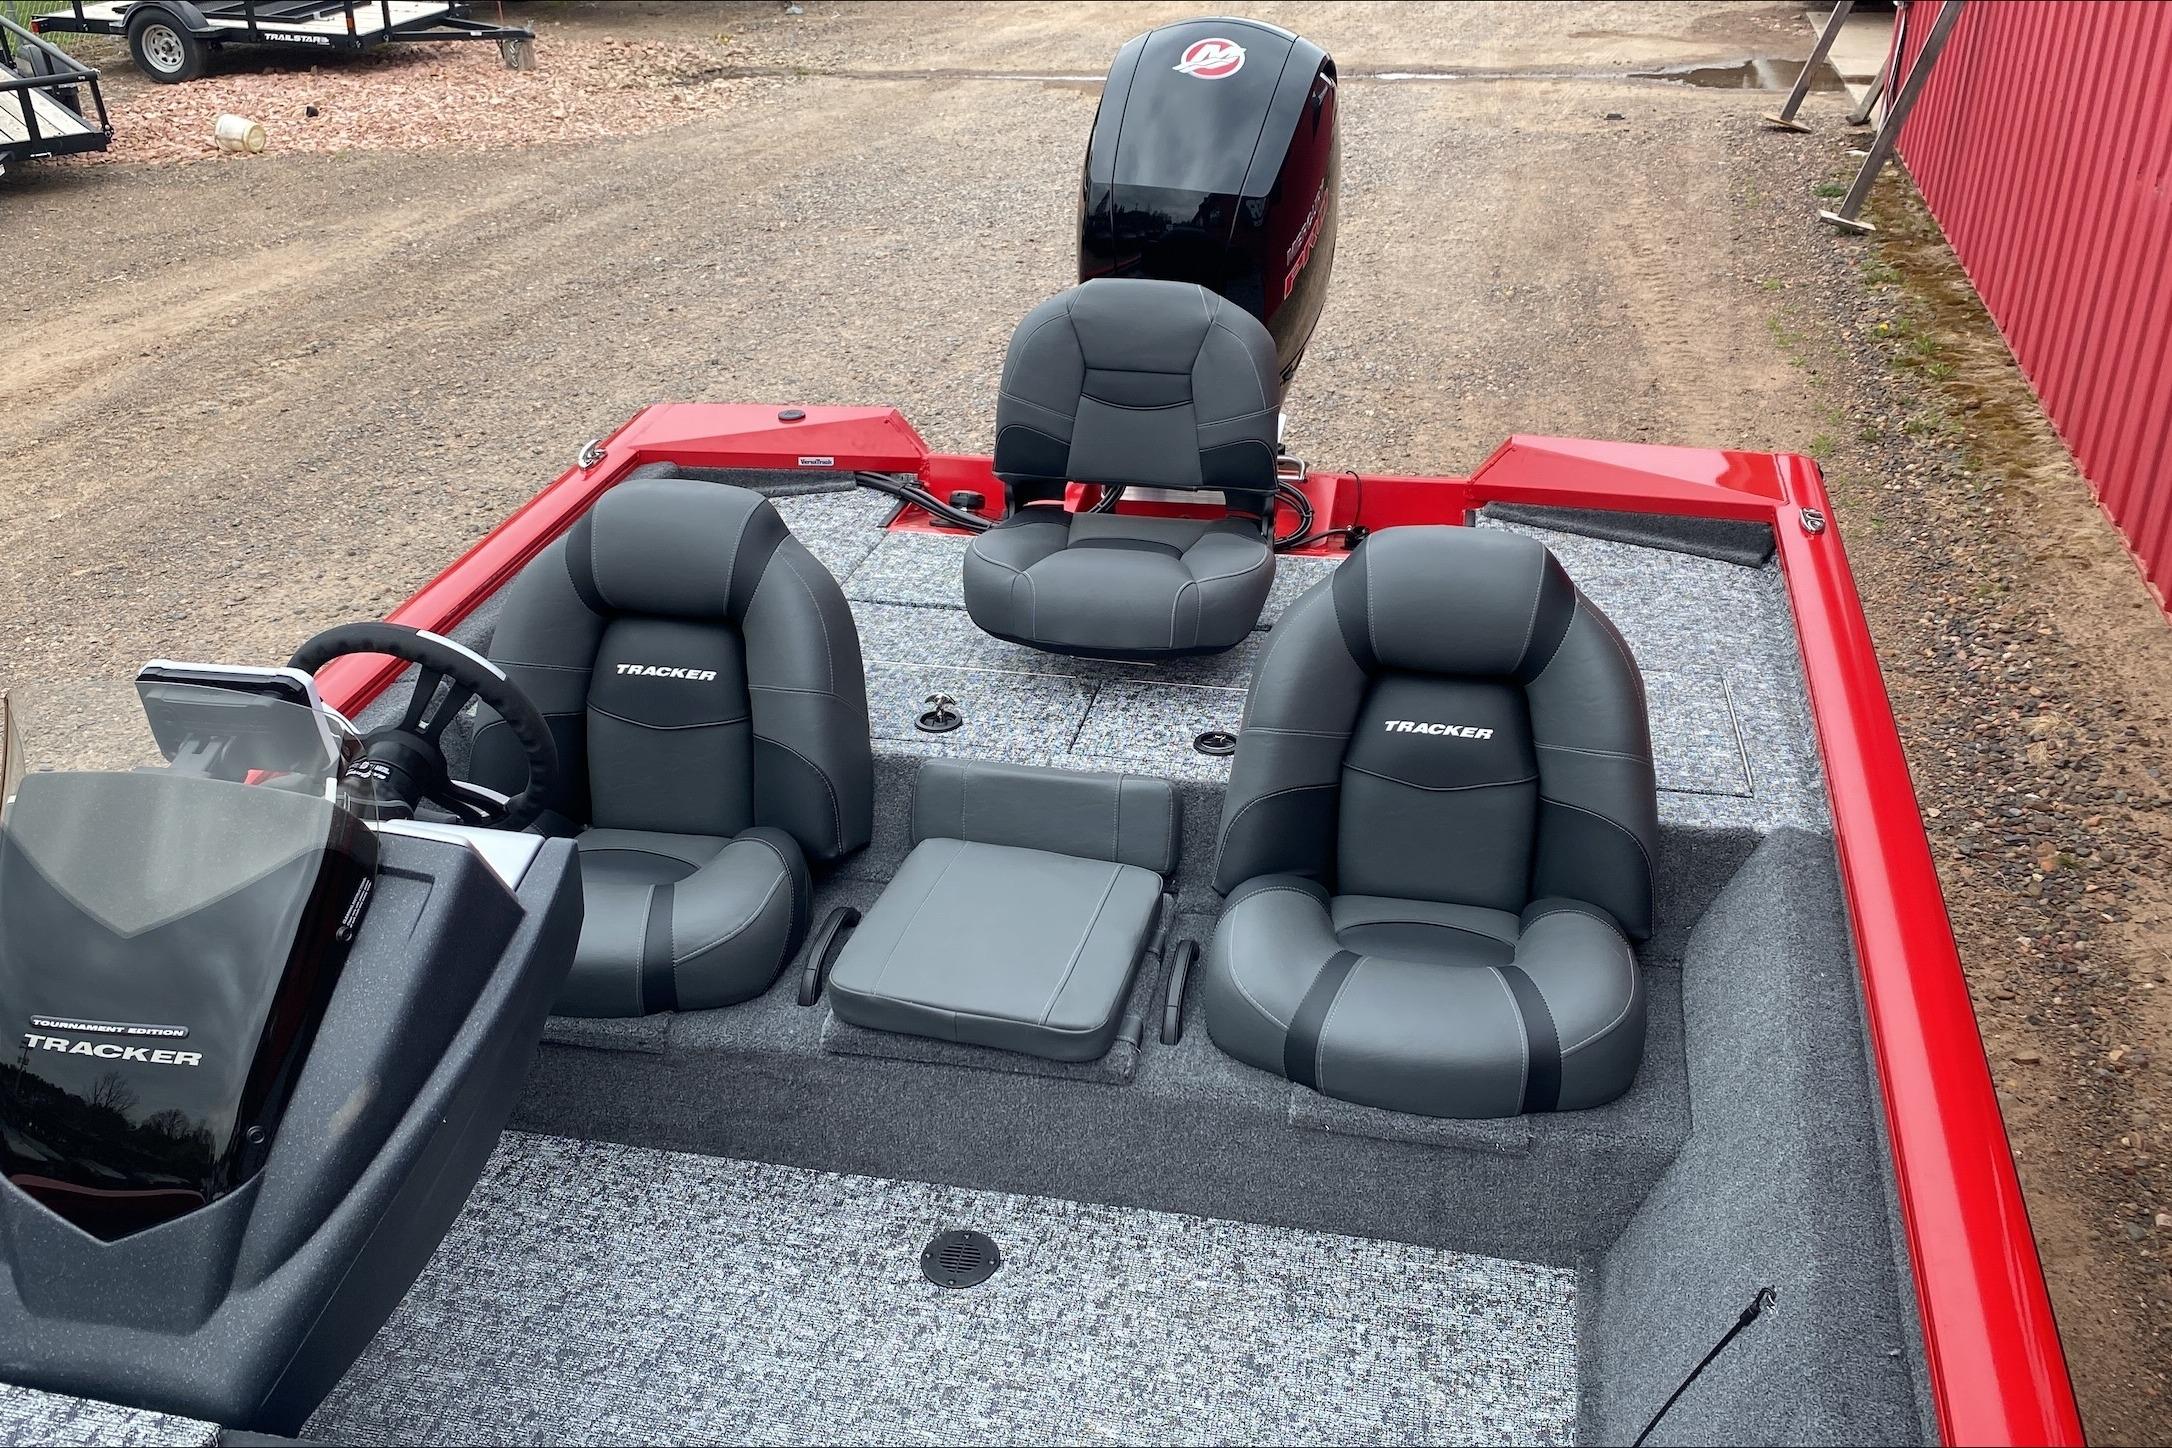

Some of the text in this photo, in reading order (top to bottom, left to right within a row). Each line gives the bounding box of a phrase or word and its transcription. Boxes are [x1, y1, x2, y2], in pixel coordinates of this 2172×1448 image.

[264, 33, 321, 43] TRAILSTAR
[616, 664, 717, 681] TRACKER
[1384, 720, 1494, 740] TRACKER
[33, 1019, 184, 1037] TOURNAMENT EDITION
[24, 1033, 203, 1067] TRACKER
